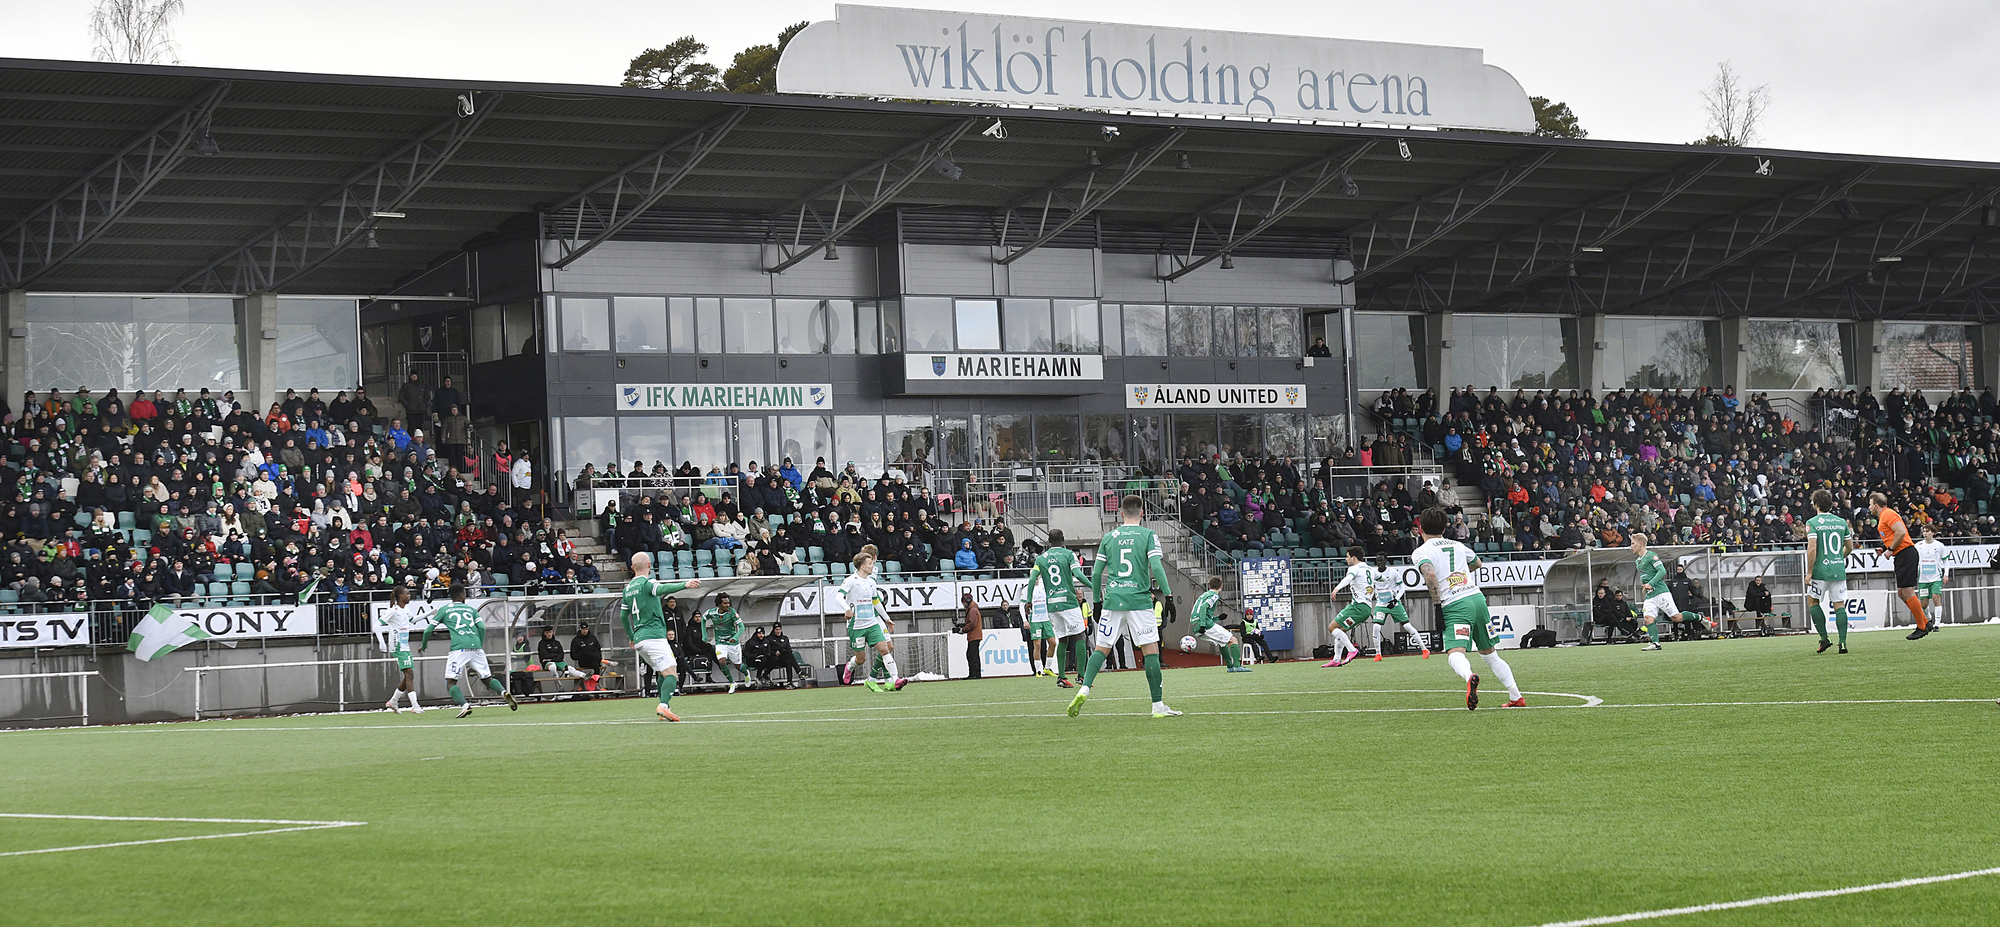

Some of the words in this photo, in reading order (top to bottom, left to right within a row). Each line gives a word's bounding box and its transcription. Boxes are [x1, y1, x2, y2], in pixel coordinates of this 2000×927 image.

[895, 19, 1065, 96] wiklöf
[1081, 28, 1276, 116] holding
[1297, 65, 1432, 117] arena
[957, 356, 1082, 377] MARIEHAMN
[646, 386, 677, 407] IFK
[682, 386, 803, 407] MARIEHAMN
[1154, 385, 1211, 404] ÅLAND
[1217, 388, 1279, 404] UNITED
[1118, 538, 1134, 546] KATZ
[1822, 531, 1842, 555] 10
[1118, 548, 1133, 577] 5
[1441, 546, 1455, 573] 7
[1948, 549, 1982, 564] AVIA
[1048, 564, 1062, 586] 8
[1365, 569, 1373, 585] 8
[1480, 564, 1546, 583] BRAVIA
[631, 597, 640, 621] 4
[784, 591, 817, 611] TV
[46, 618, 86, 640] TV
[448, 611, 475, 630] 29
[1490, 614, 1514, 632] EA
[984, 645, 1030, 665] ruut
